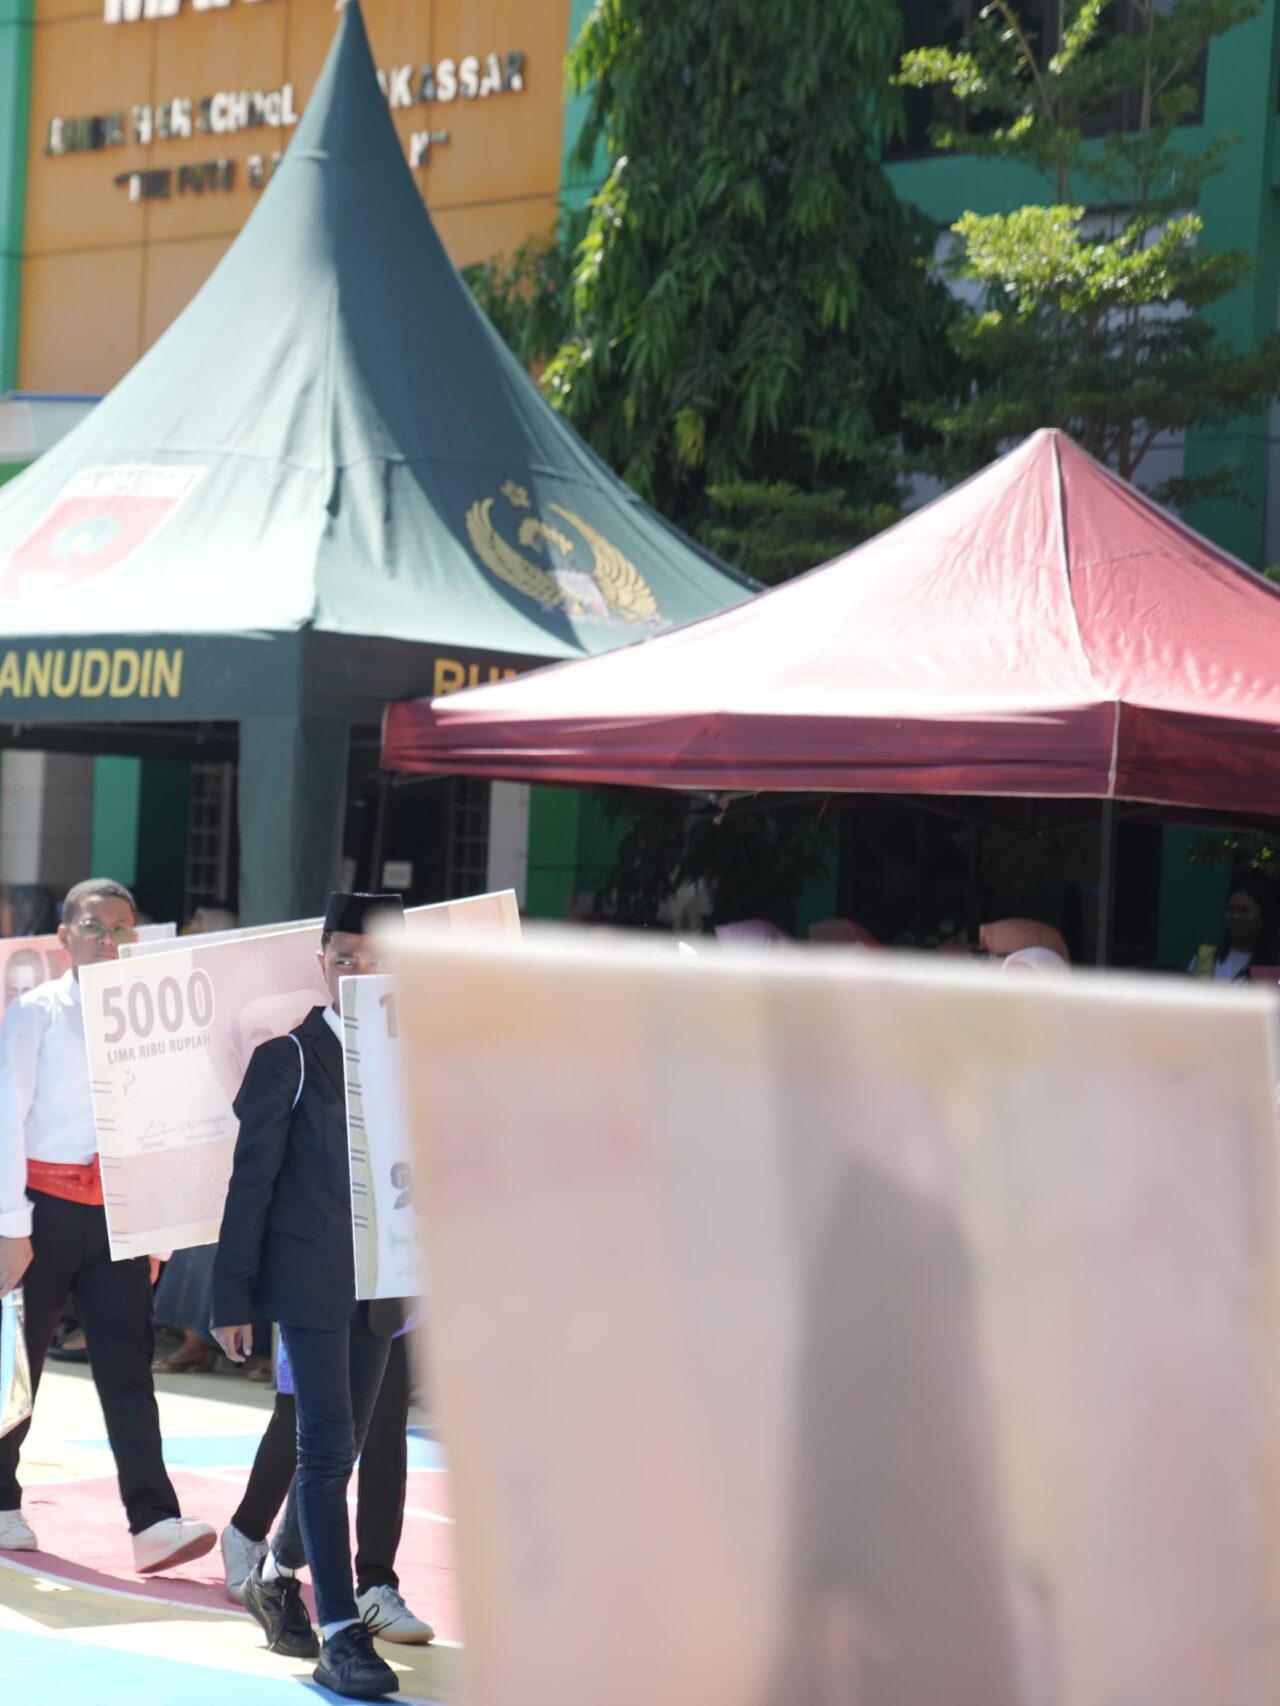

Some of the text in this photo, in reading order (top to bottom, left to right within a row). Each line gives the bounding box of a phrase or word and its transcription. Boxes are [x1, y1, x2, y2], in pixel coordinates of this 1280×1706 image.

[101, 968, 216, 1045] 5000
[106, 1033, 212, 1065] LIMA RIBU RUPIAH
